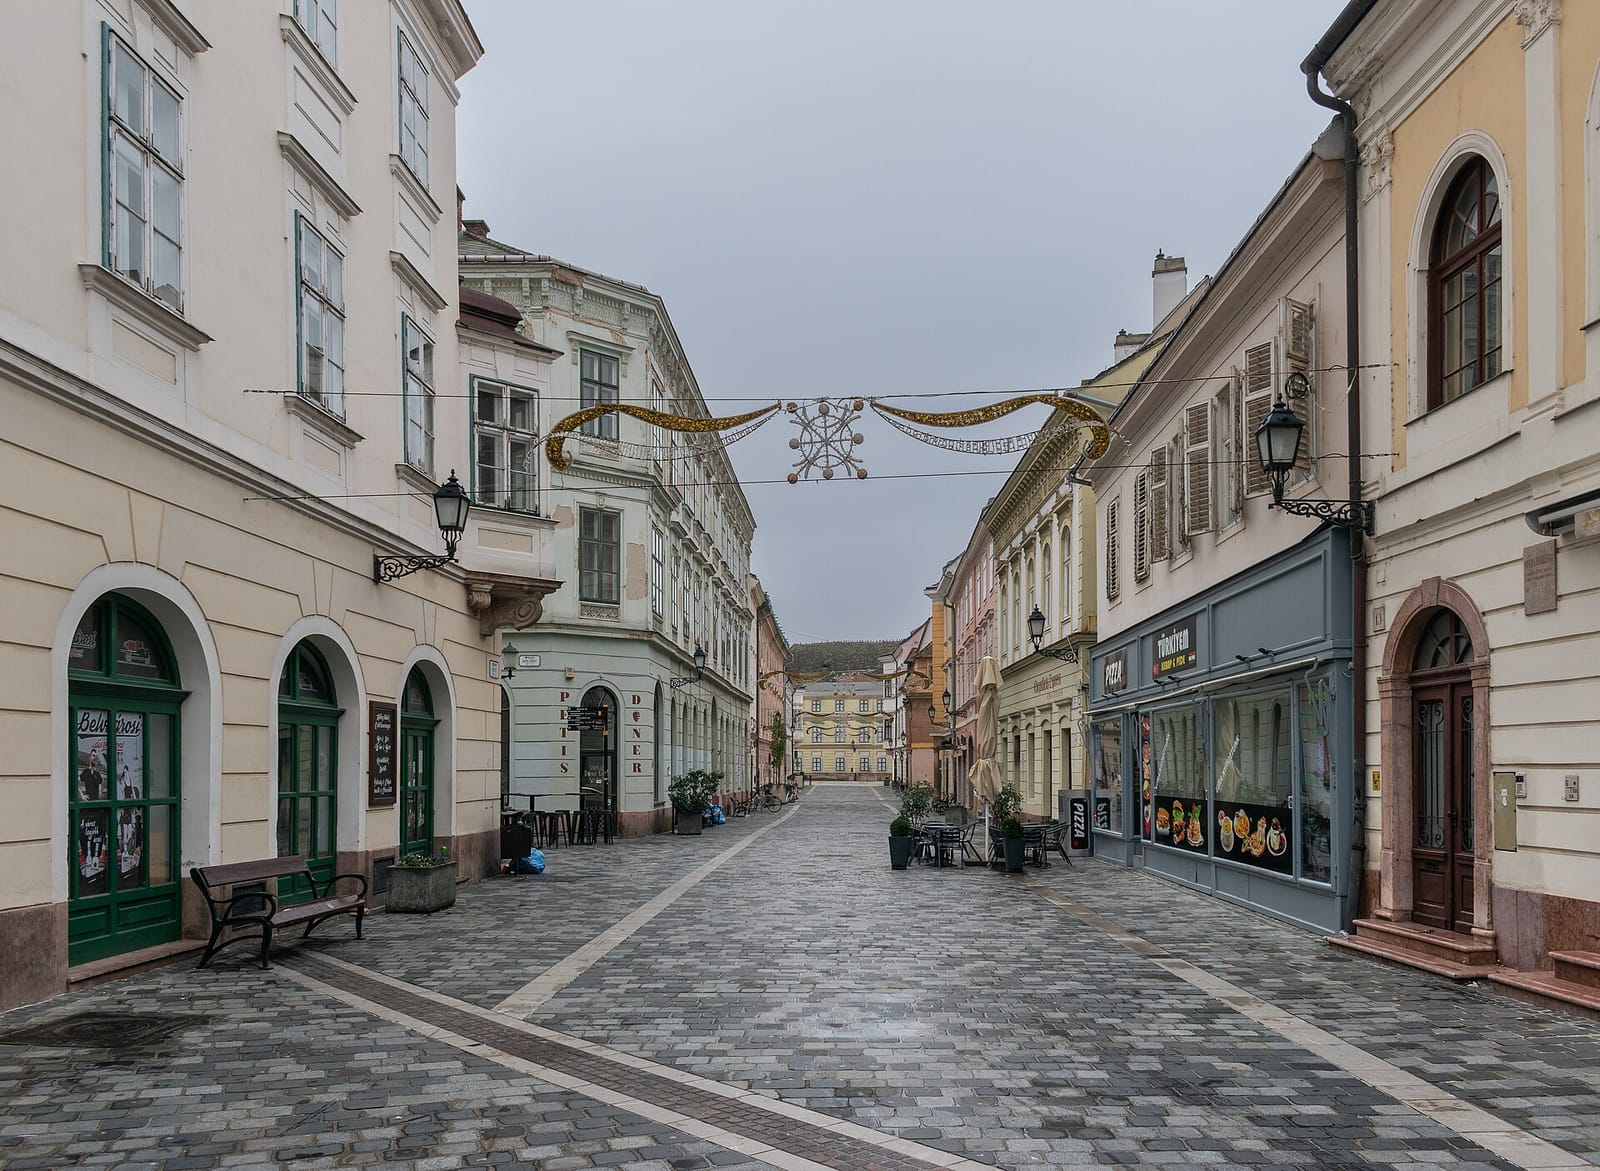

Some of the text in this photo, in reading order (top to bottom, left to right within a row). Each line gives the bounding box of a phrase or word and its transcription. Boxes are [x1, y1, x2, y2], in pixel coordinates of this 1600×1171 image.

[1105, 659, 1122, 687] PIZZA
[560, 691, 570, 774] PETIS
[1073, 802, 1085, 838] PIZZA
